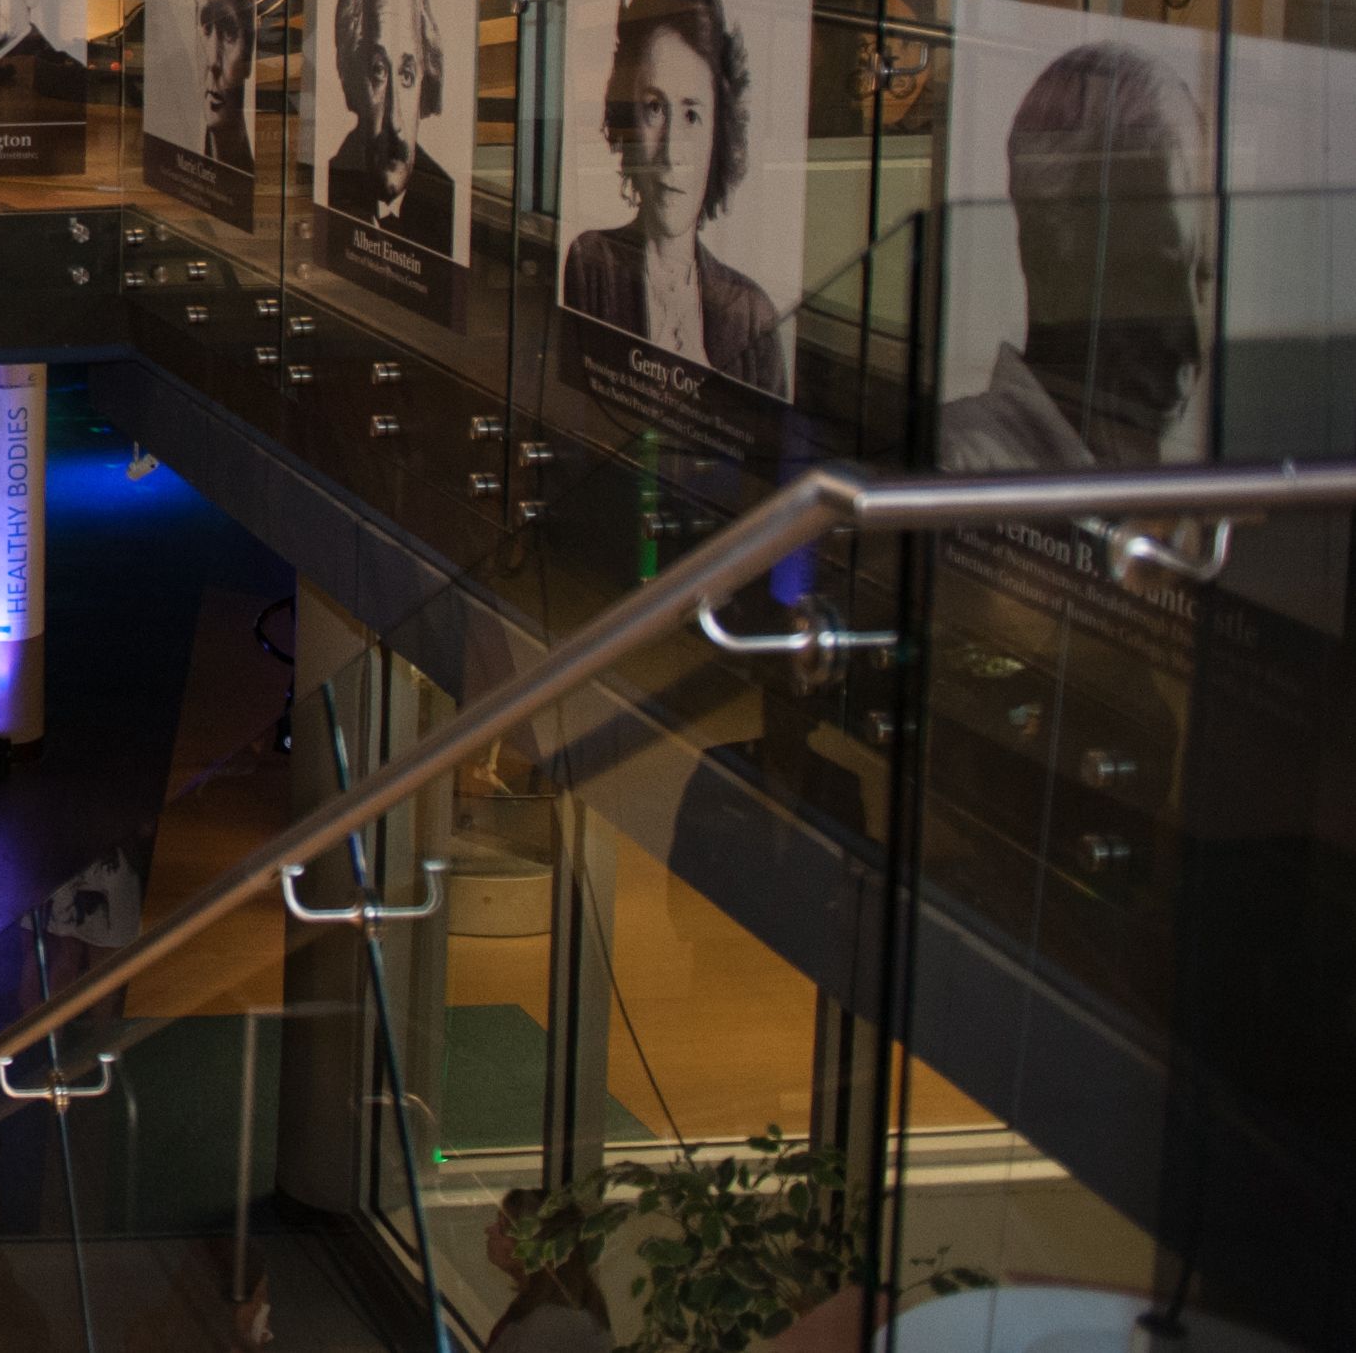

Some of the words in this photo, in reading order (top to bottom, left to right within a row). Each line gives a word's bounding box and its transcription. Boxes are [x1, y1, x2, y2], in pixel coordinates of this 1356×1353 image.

[353, 229, 381, 257] Albert
[383, 240, 421, 275] Einstein
[629, 348, 670, 389] Gerty
[7, 406, 28, 497] BODIES
[7, 506, 28, 614] HEALTHY
[994, 520, 1072, 564] ernon
[1075, 544, 1100, 579] B.
